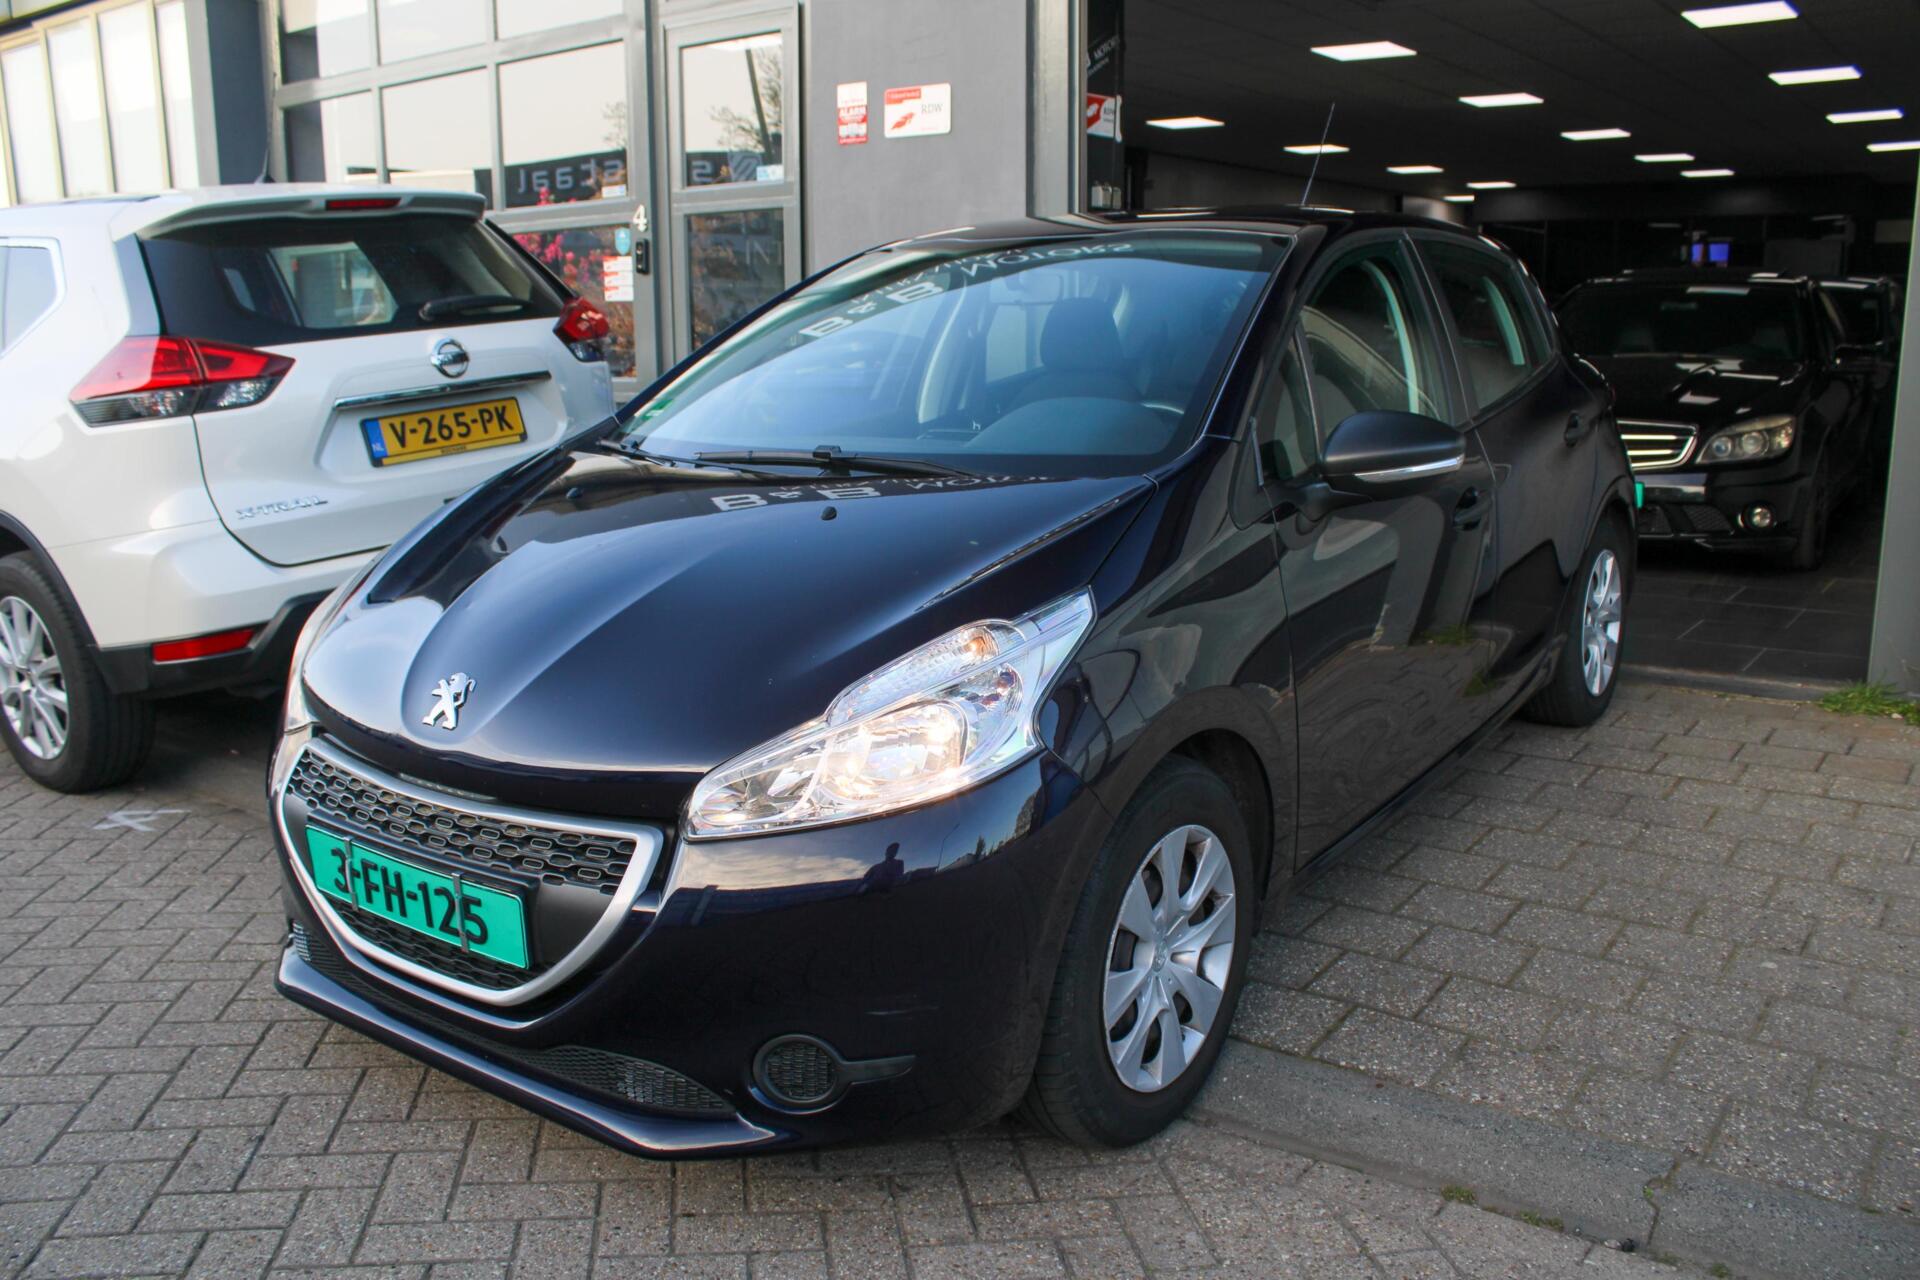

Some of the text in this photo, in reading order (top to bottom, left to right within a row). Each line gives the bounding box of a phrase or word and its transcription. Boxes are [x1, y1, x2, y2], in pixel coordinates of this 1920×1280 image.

[633, 204, 648, 232] 4
[389, 405, 514, 448] V-265-PK
[235, 496, 329, 520] X-TRAIL
